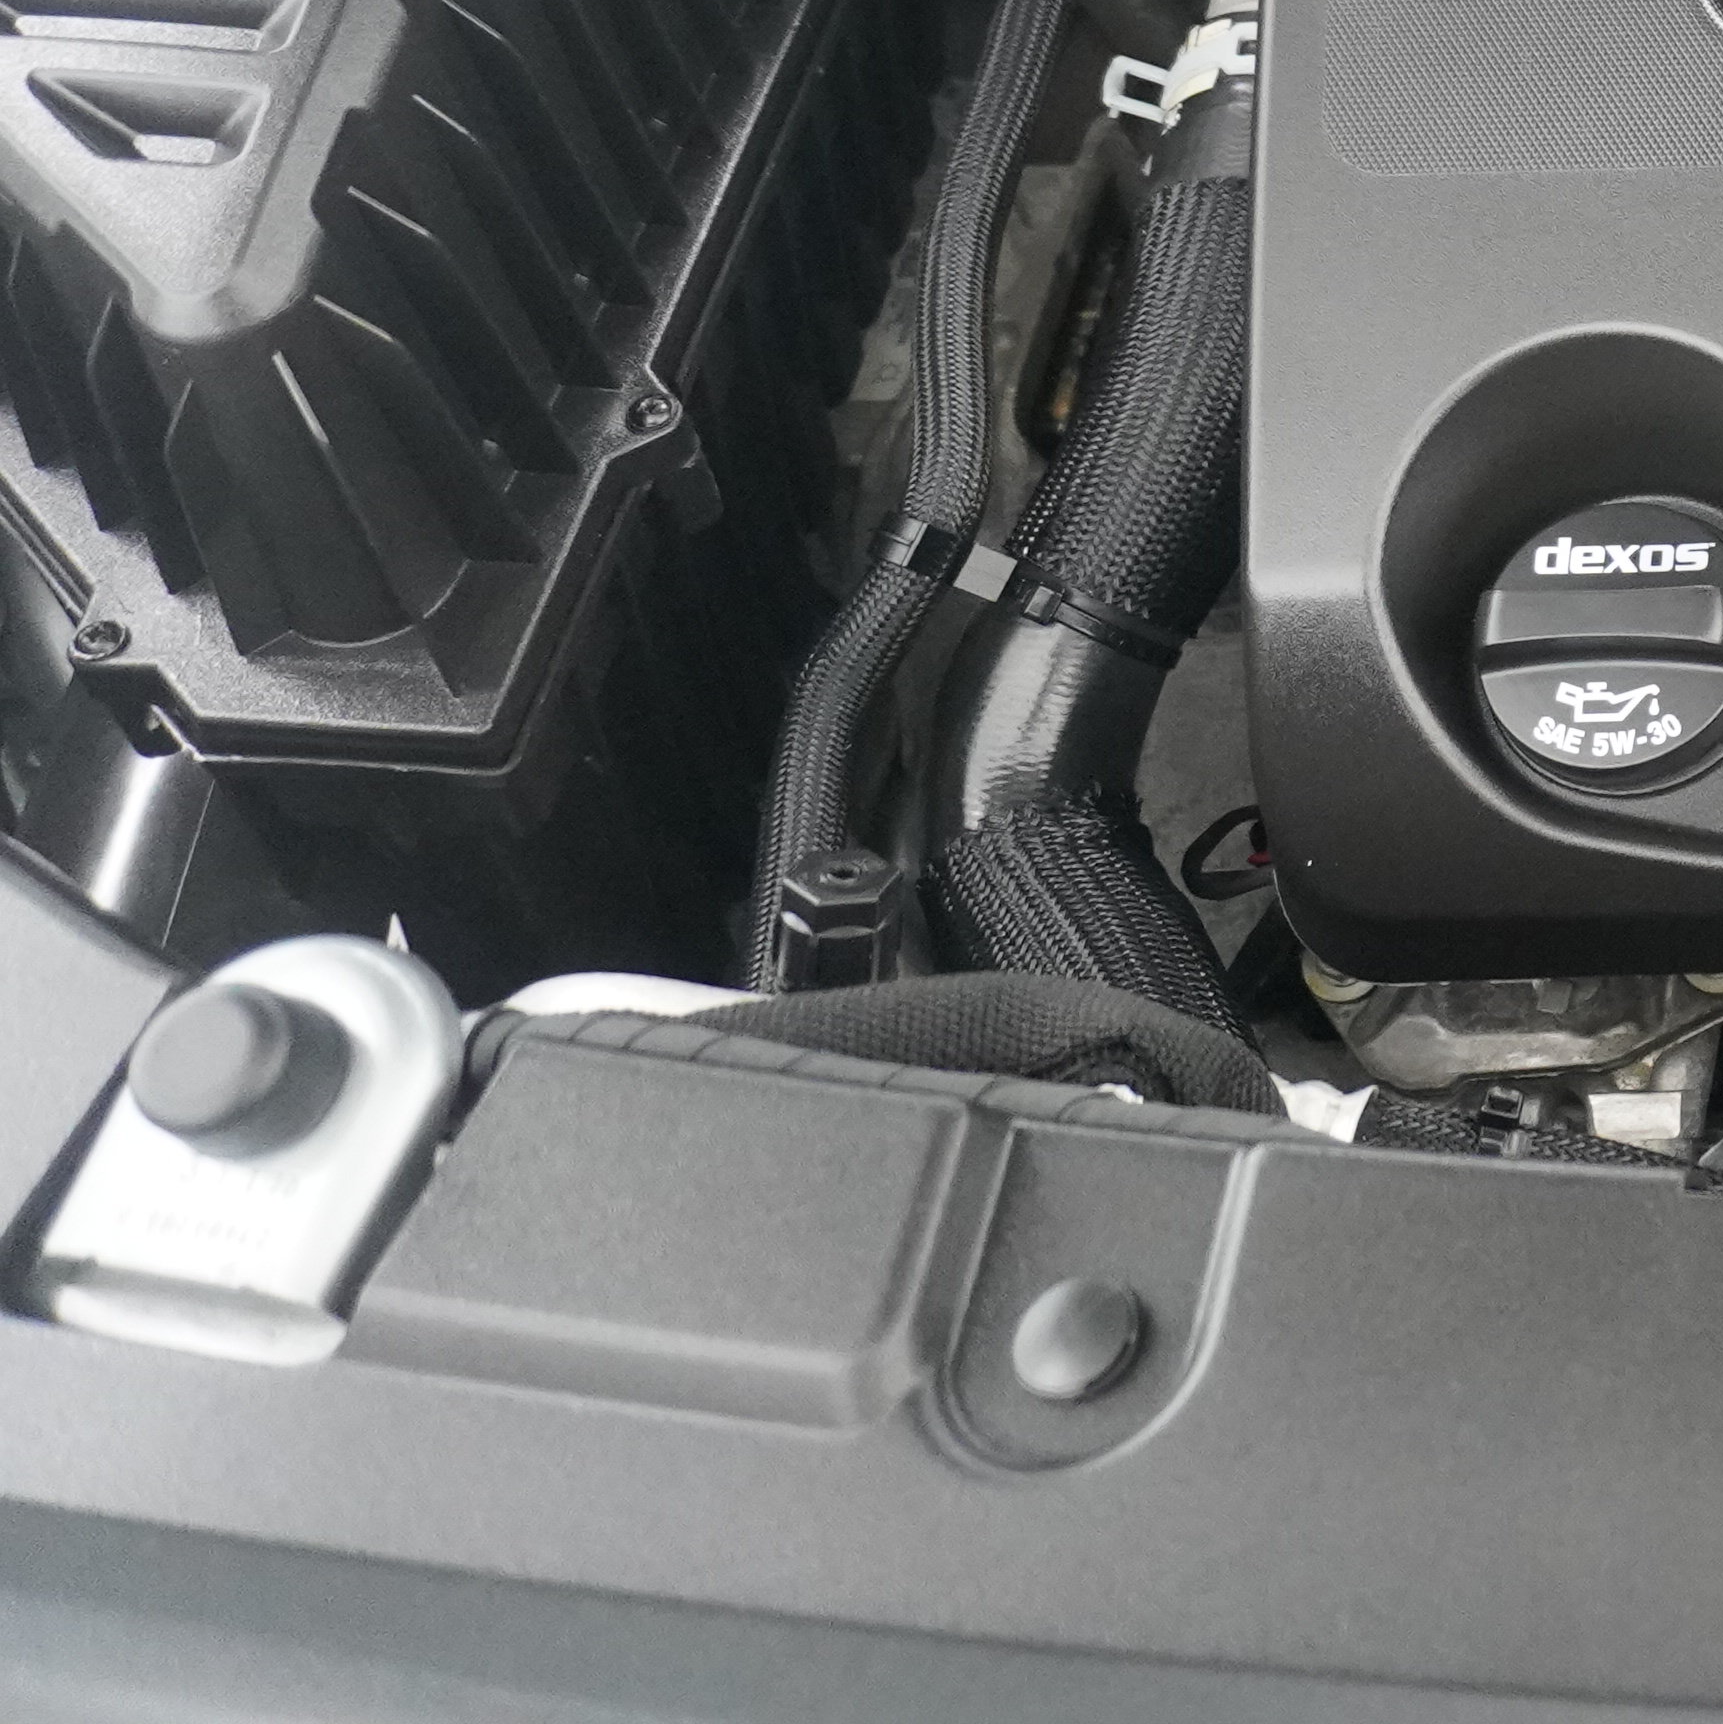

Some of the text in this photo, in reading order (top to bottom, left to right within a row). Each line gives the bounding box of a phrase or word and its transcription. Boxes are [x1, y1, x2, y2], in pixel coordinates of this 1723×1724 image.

[1533, 536, 1712, 575] dexos
[1533, 713, 1683, 757] SAE 5W-30
